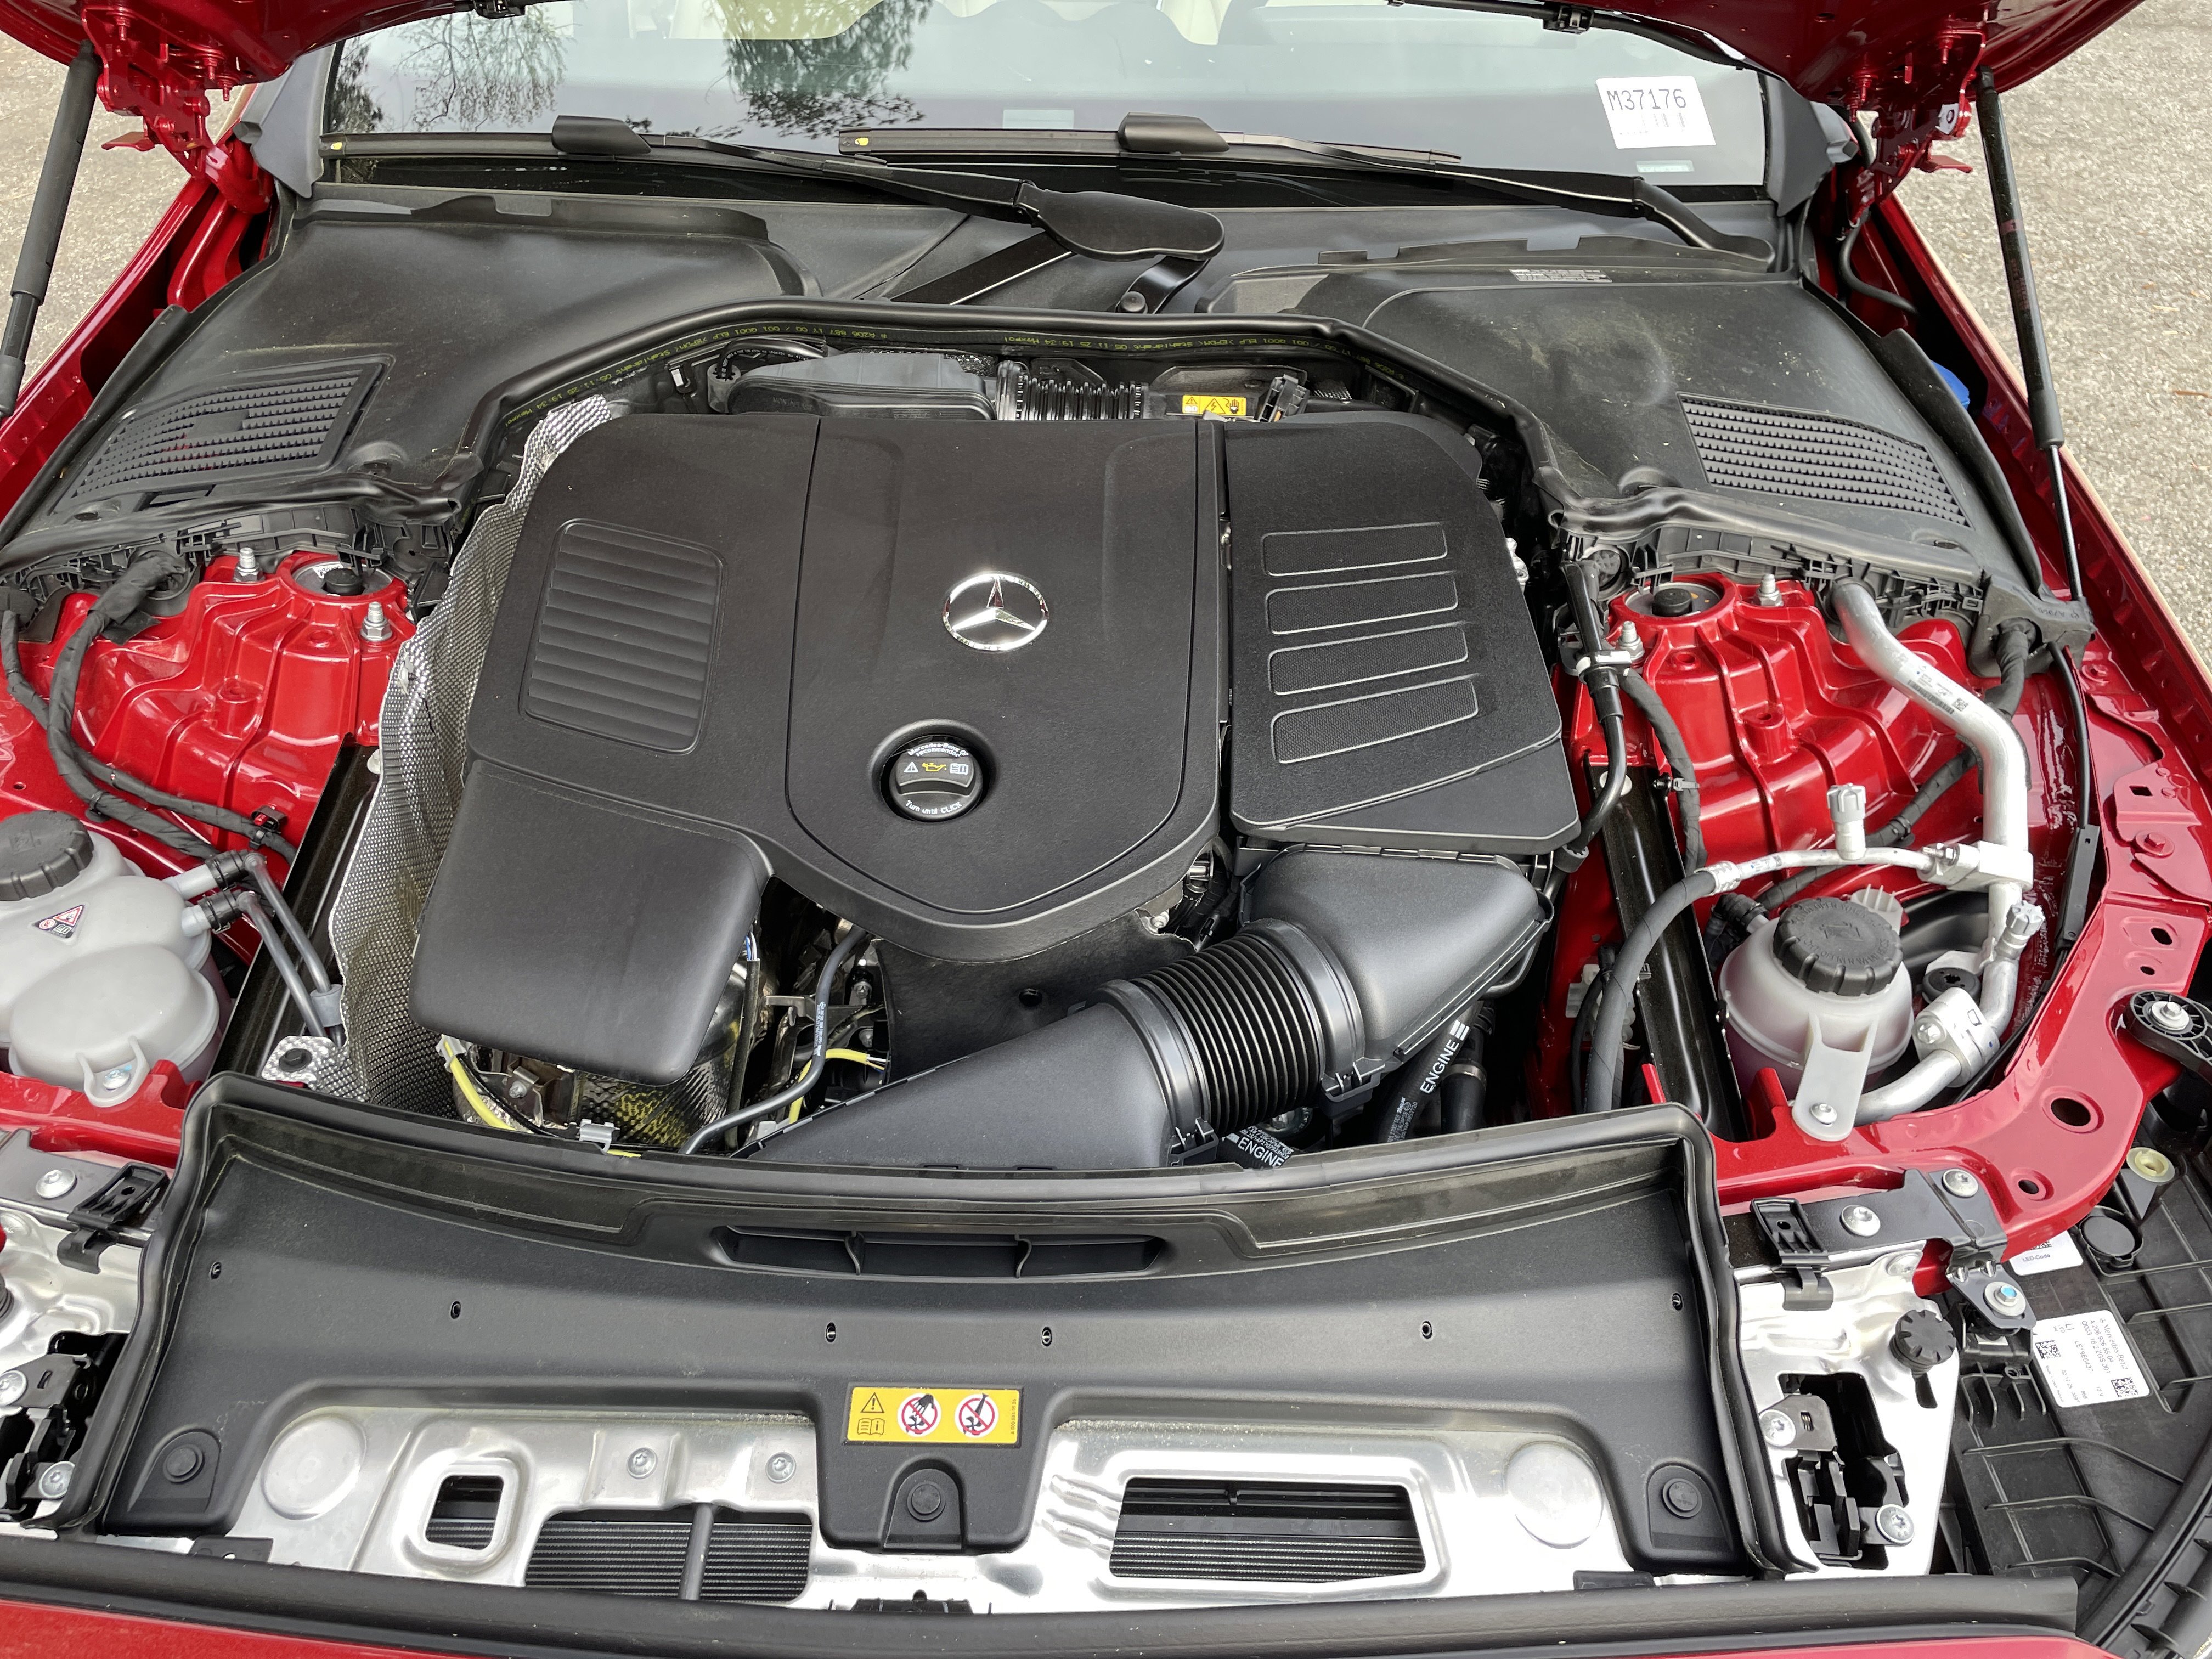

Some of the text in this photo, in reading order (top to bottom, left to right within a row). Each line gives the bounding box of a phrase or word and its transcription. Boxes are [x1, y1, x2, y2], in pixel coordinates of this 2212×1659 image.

[1606, 88, 1686, 111] M37176
[907, 742, 960, 755] Mercedes-Benz
[905, 800, 921, 812] Turn
[940, 801, 963, 814] CLICK
[1420, 1039, 1460, 1094] ENGINE
[2022, 1254, 2051, 1262] LED-Code
[2081, 1321, 2093, 1336] Q003
[2095, 1350, 2106, 1363] ZGS
[2092, 1325, 2102, 1335] 206
[2097, 1336, 2107, 1346] 906
